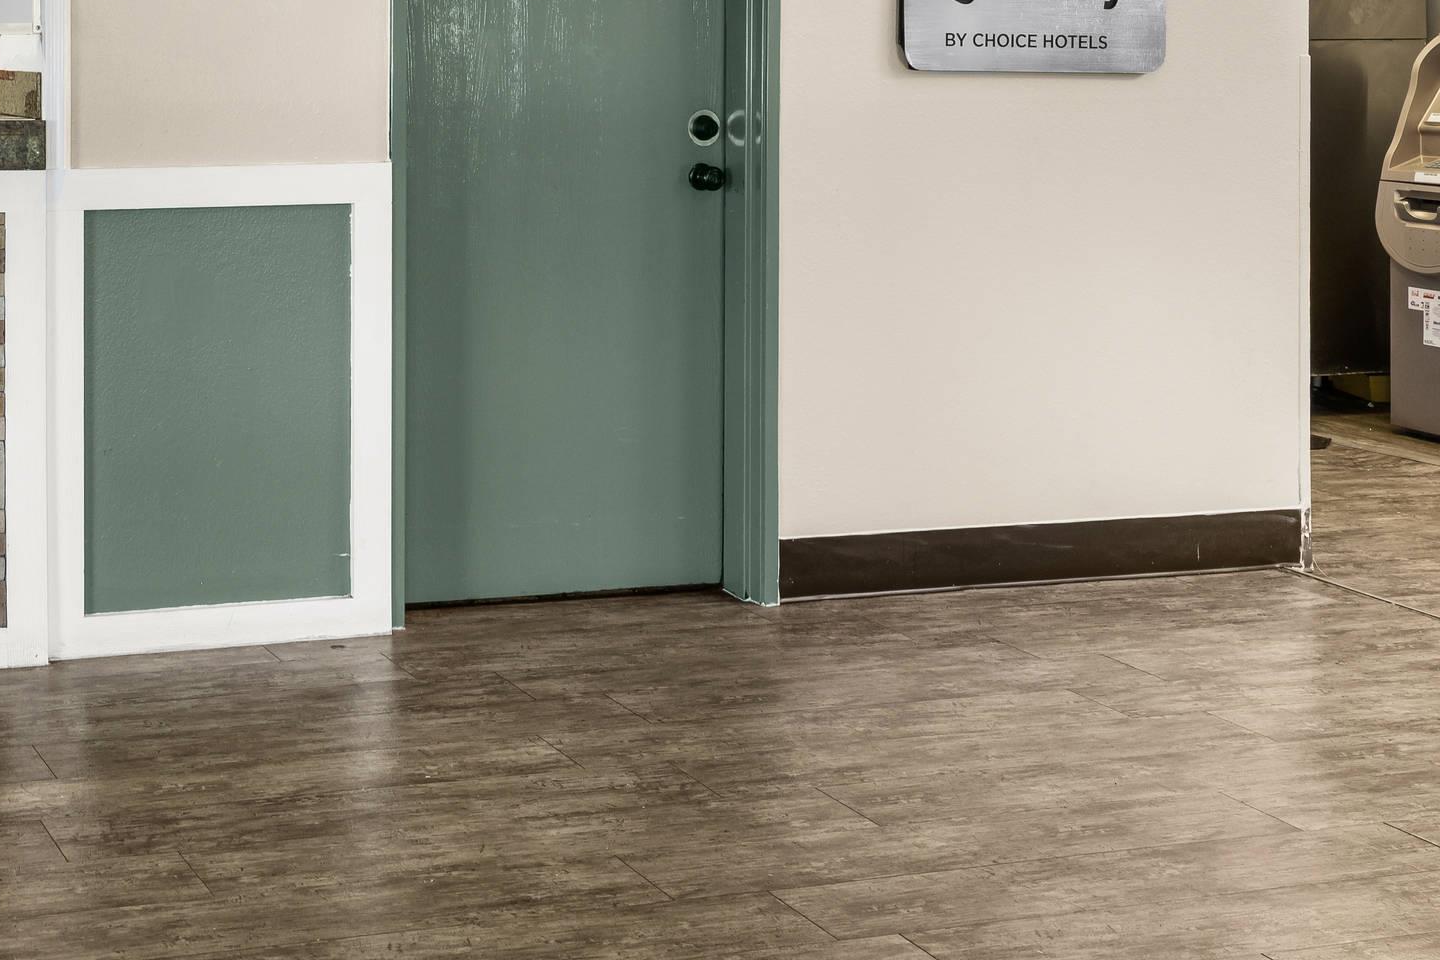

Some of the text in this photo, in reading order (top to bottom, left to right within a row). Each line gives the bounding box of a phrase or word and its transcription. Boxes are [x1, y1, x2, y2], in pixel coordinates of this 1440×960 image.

[945, 33, 1108, 50] BY CHOICE HOTELS
